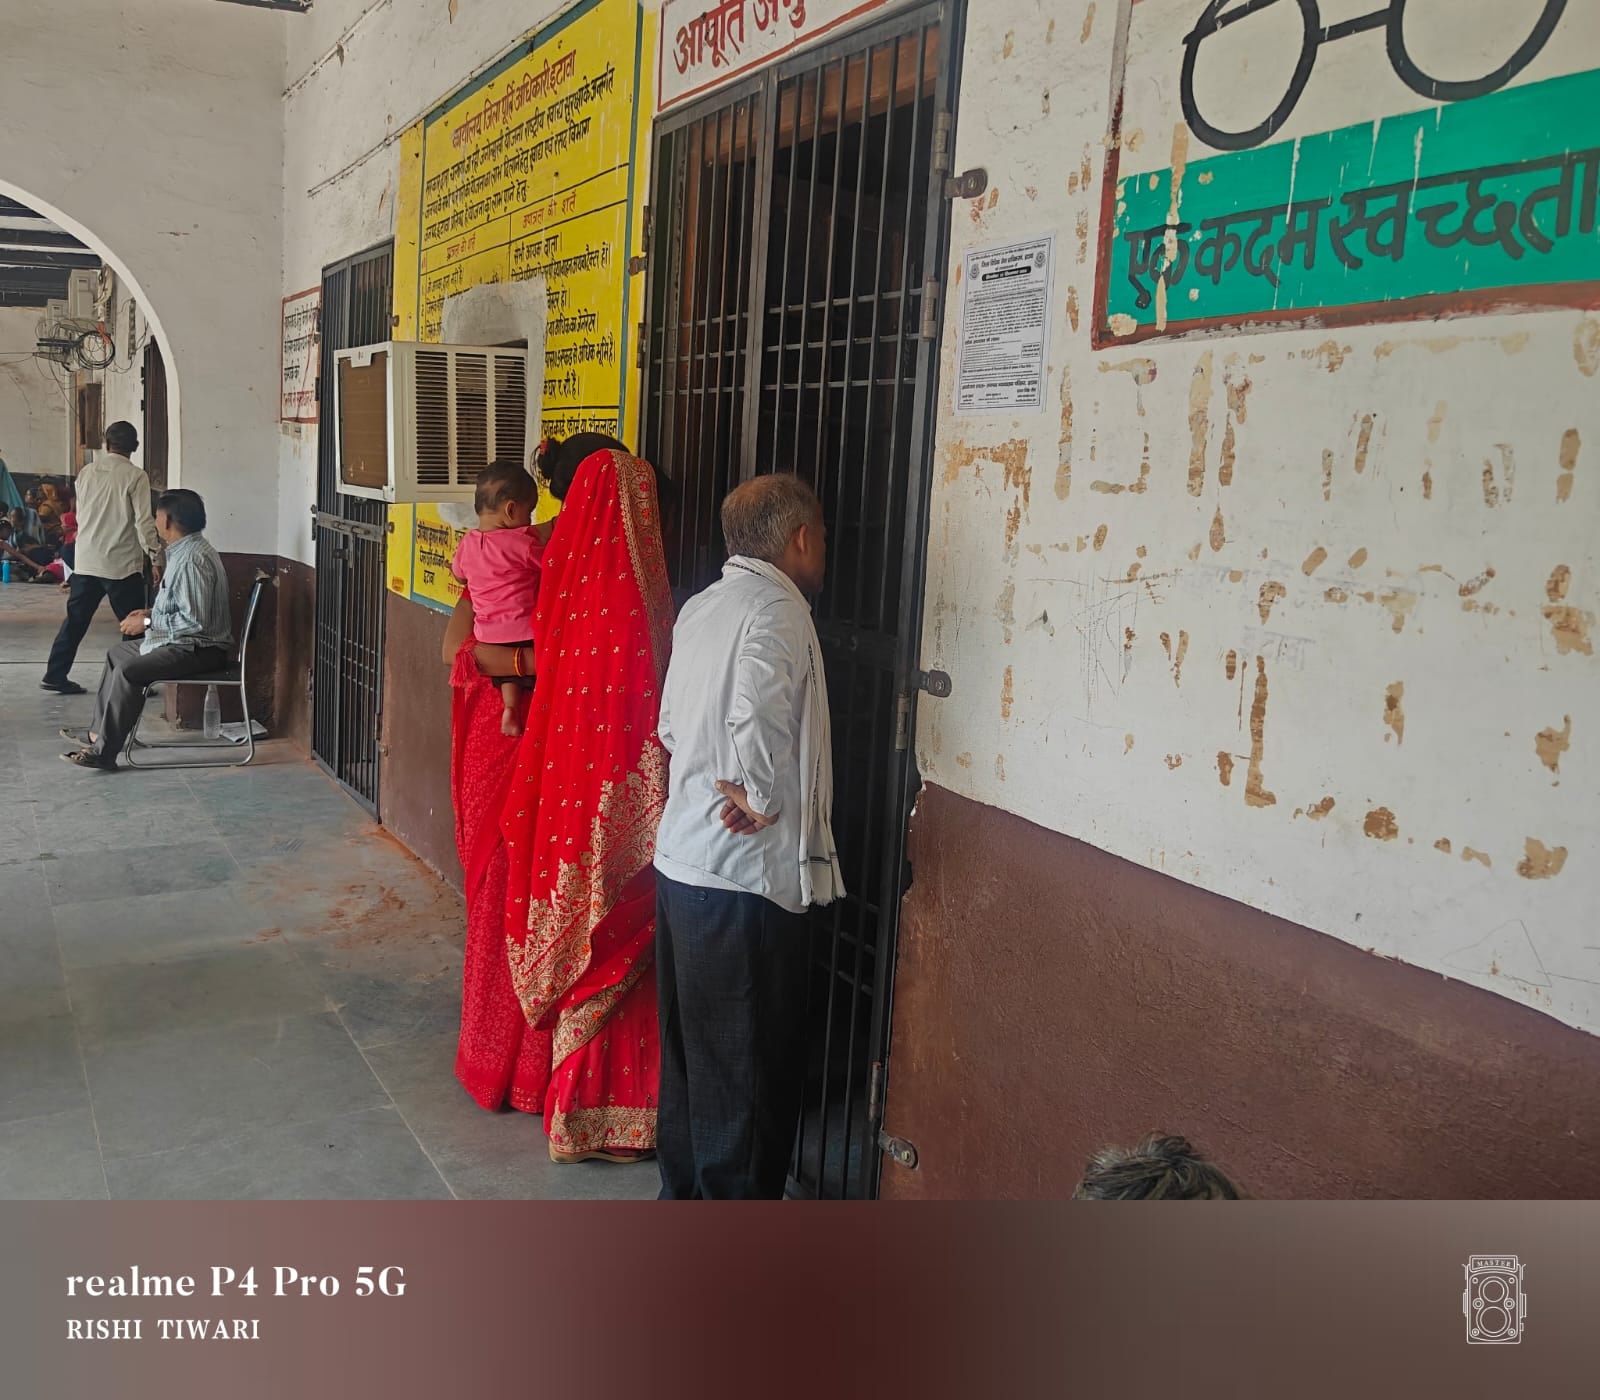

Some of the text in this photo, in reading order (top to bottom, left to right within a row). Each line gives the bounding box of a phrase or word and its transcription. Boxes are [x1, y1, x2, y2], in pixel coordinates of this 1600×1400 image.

[504, 123, 524, 150] योजना
[525, 107, 546, 141] राष्ट्रीय
[547, 99, 564, 129] खाद्य
[565, 87, 583, 123] सुरक्षा
[582, 76, 591, 104] के
[514, 58, 550, 112] अधिकारी
[549, 49, 576, 96] इटावा
[519, 147, 530, 175] हेतु
[554, 129, 568, 156] रसद
[567, 116, 592, 144] विभाग
[1125, 146, 1600, 310] एक कदम स्वच्छता
